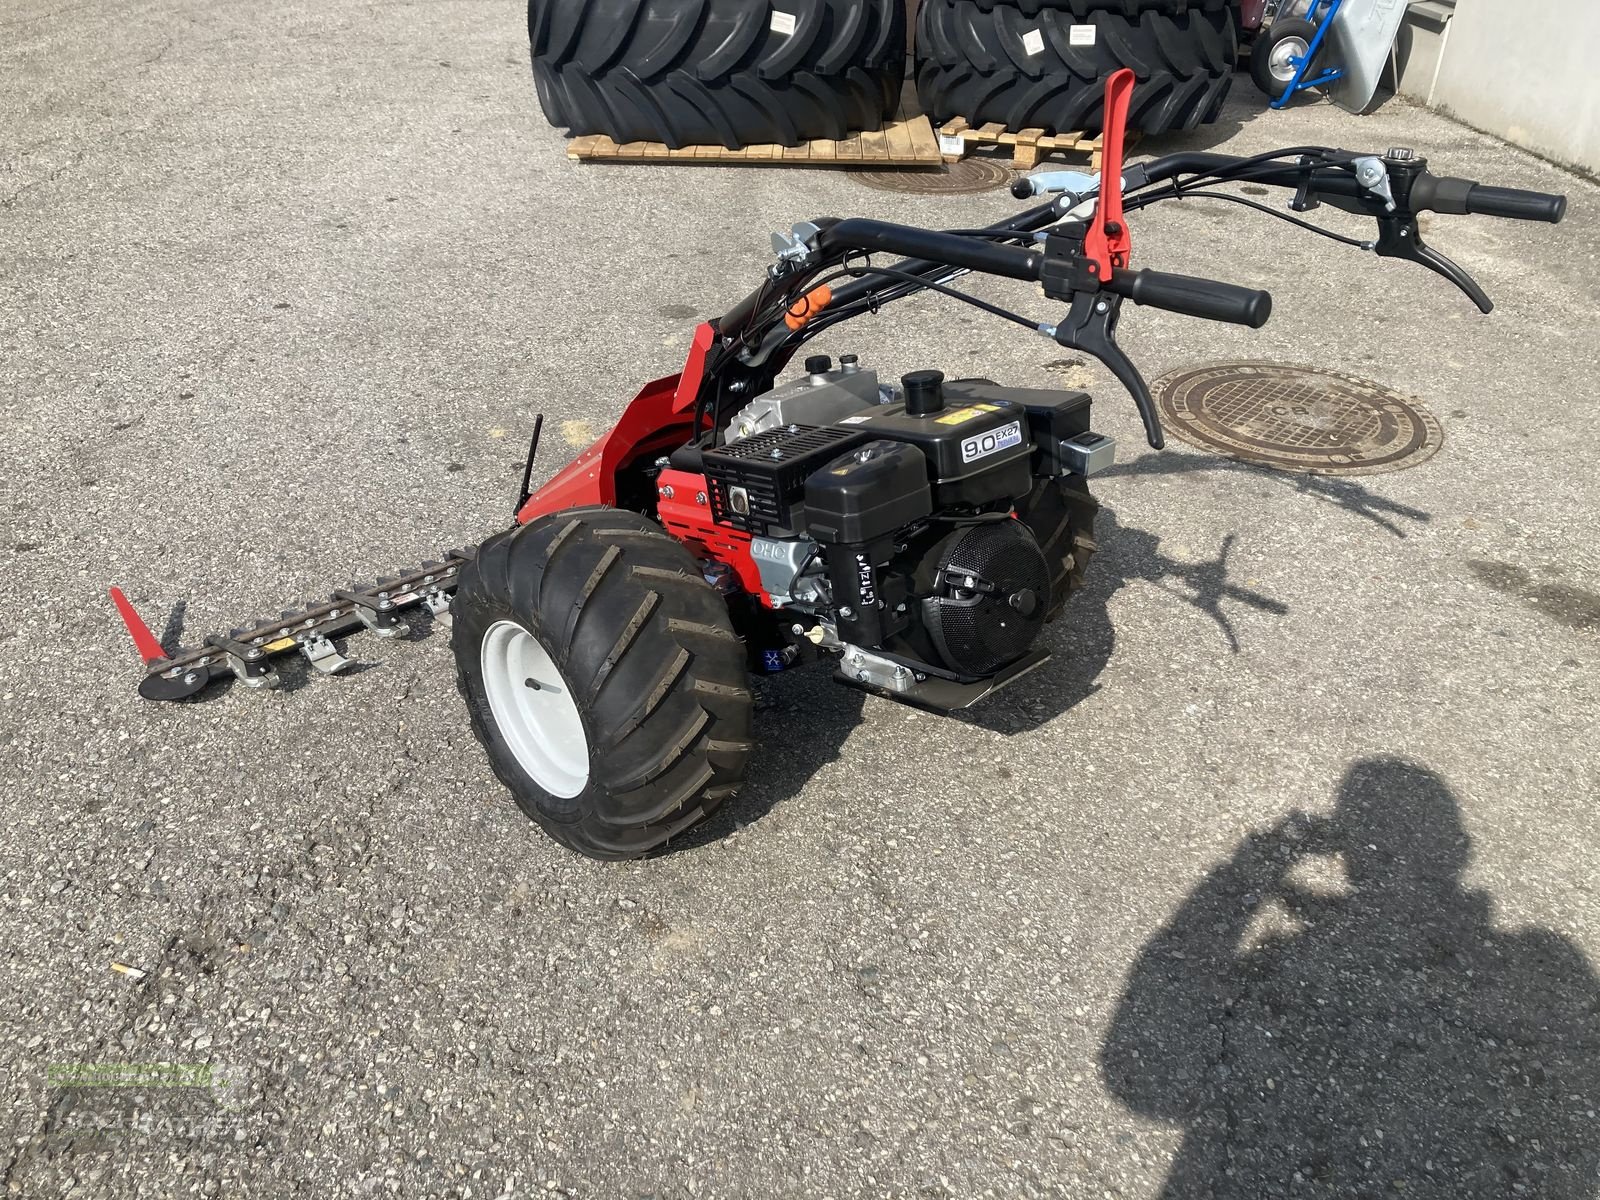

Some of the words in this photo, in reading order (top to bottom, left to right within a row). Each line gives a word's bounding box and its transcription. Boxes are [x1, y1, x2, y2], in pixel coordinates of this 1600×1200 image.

[964, 434, 996, 458] 9.0
[995, 425, 1018, 441] EX27
[753, 542, 786, 559] OHC
